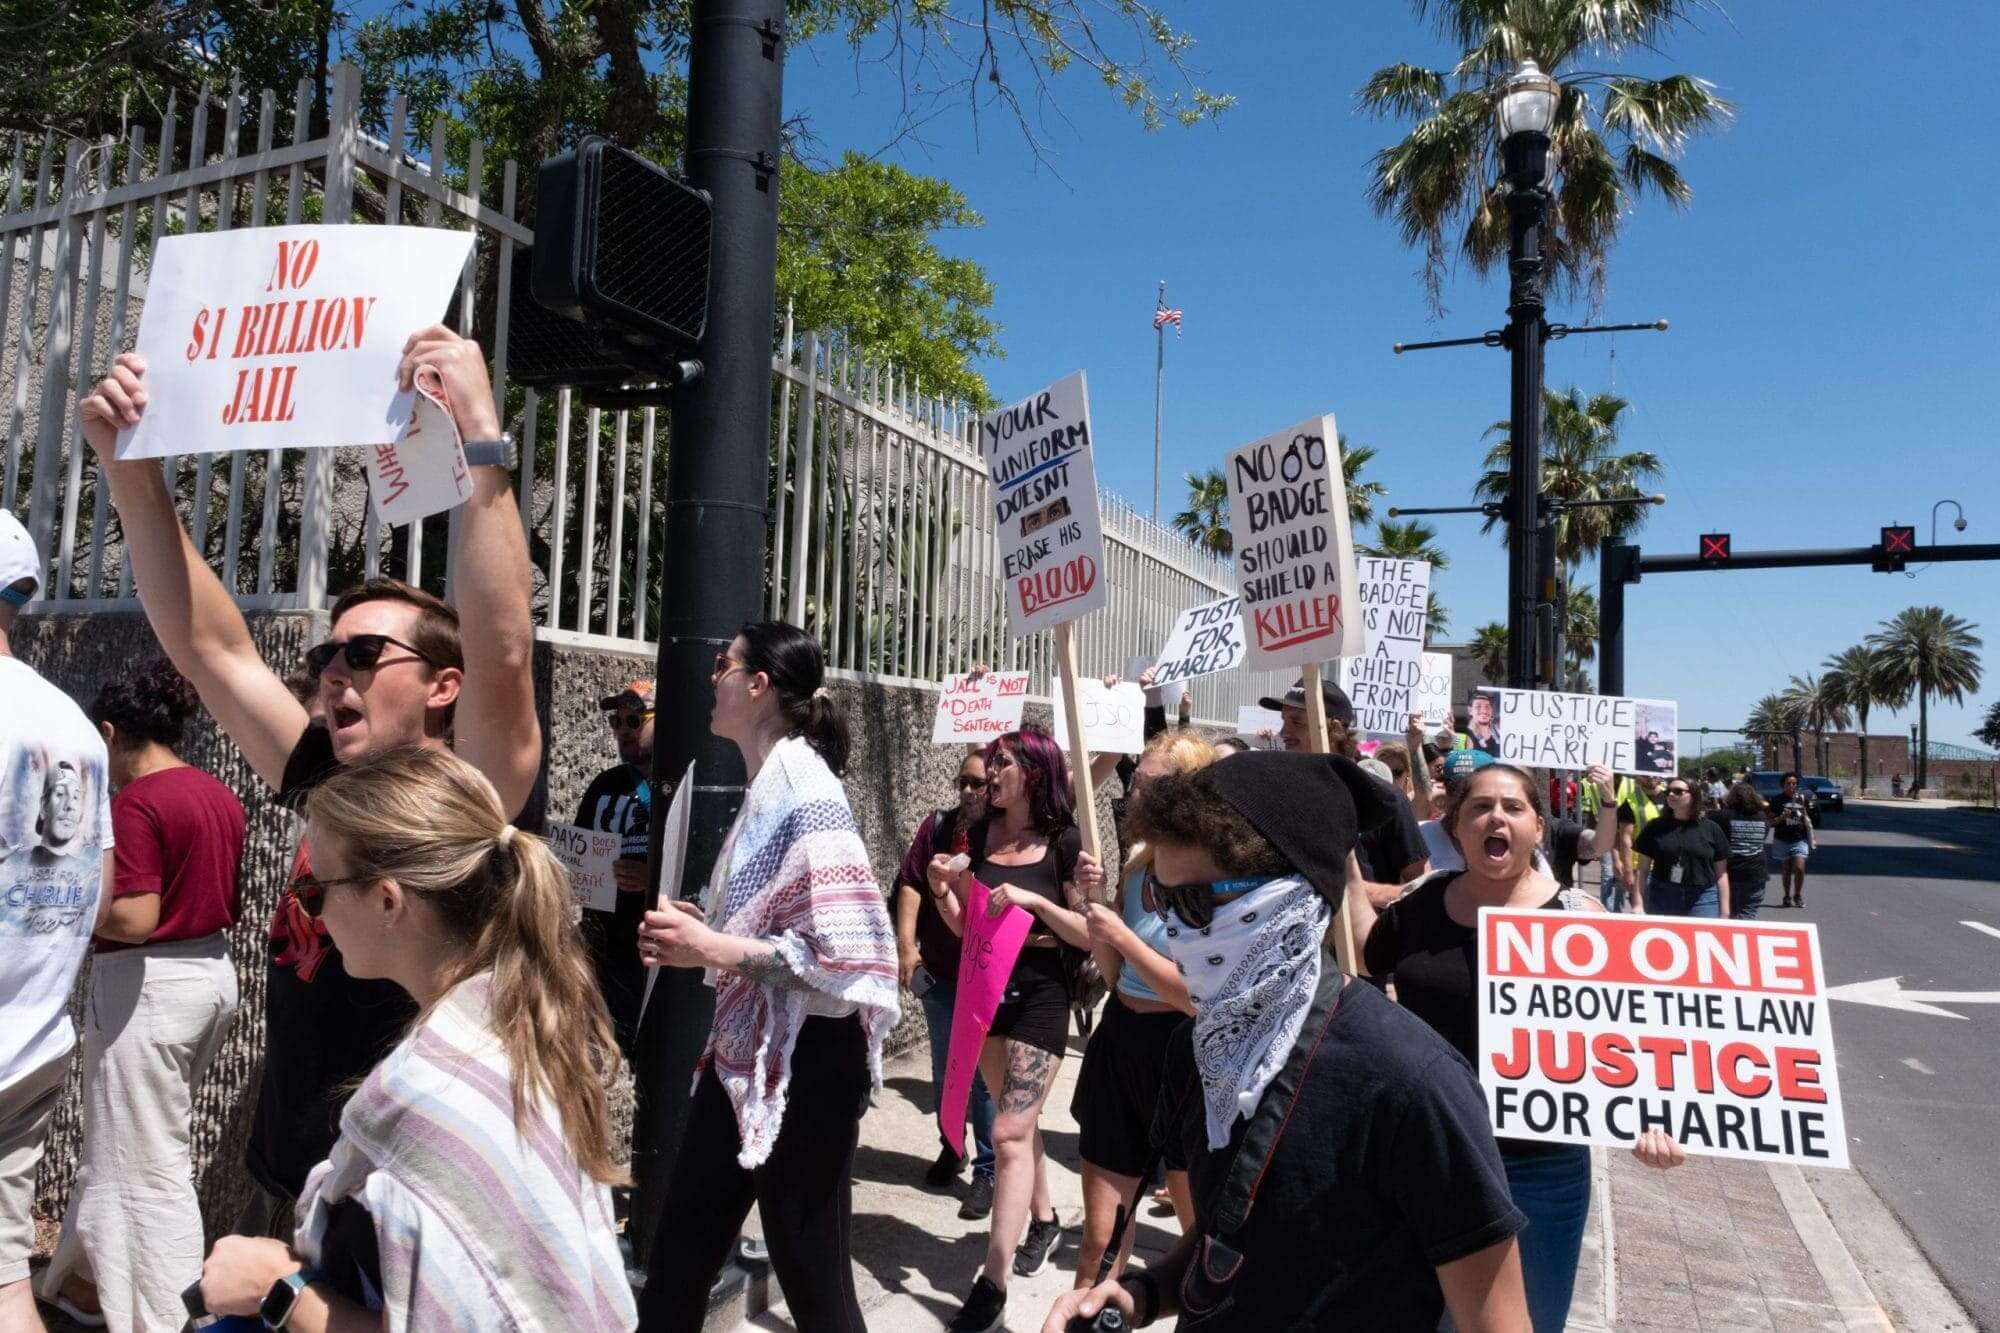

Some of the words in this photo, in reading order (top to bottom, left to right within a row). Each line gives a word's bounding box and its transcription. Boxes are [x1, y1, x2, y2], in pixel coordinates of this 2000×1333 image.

[266, 240, 320, 292] NO
[186, 303, 228, 366] $1
[231, 297, 376, 359] BILLION
[222, 366, 298, 425] JAIL
[985, 392, 1059, 453] YOUR
[993, 421, 1090, 486] UNIFORM
[1235, 444, 1276, 493] NO
[996, 463, 1070, 524] DOESNT
[1247, 478, 1329, 534] BADGE
[1003, 537, 1052, 579] ERASE
[1060, 521, 1083, 547] HIS
[1240, 525, 1328, 572] SHOULD
[1018, 555, 1097, 614] BLOOD
[1243, 564, 1316, 604] SHIELD
[1324, 561, 1336, 586] A
[1368, 560, 1415, 582] THE
[1184, 596, 1241, 631] JUSTI
[1359, 582, 1427, 609] BADGE
[1186, 622, 1234, 656] FOR
[1254, 593, 1344, 648] KILLER
[1363, 607, 1378, 630] IS
[1387, 609, 1426, 637] NOT
[1152, 641, 1241, 686] CHARLES
[1376, 640, 1389, 658] A
[945, 677, 981, 694] JAIL
[986, 675, 998, 684] IS
[998, 677, 1028, 692] NOT
[1350, 658, 1420, 688] SHIELD
[1419, 674, 1449, 696] SO?
[942, 699, 949, 709] A
[951, 697, 992, 716] DEATH
[1352, 683, 1410, 711] FROM
[1503, 692, 1633, 727] JUSTICE
[953, 717, 1013, 733] SENTENCE
[1352, 707, 1409, 733] JUSTIC
[1503, 733, 1629, 771] CHARLIE
[550, 826, 587, 855] DAYS
[592, 836, 616, 847] DOES
[592, 847, 612, 857] NOT
[1496, 921, 1609, 977] NO
[1630, 928, 1804, 990] ONE
[1489, 981, 1517, 1015] IS
[1527, 983, 1647, 1024] ABOVE
[1654, 991, 1726, 1029] THE
[1735, 998, 1815, 1036] LAW
[1491, 1028, 1828, 1104] JUSTICE
[1496, 1087, 1591, 1137] FOR
[1605, 1096, 1829, 1158] CHARLIE
